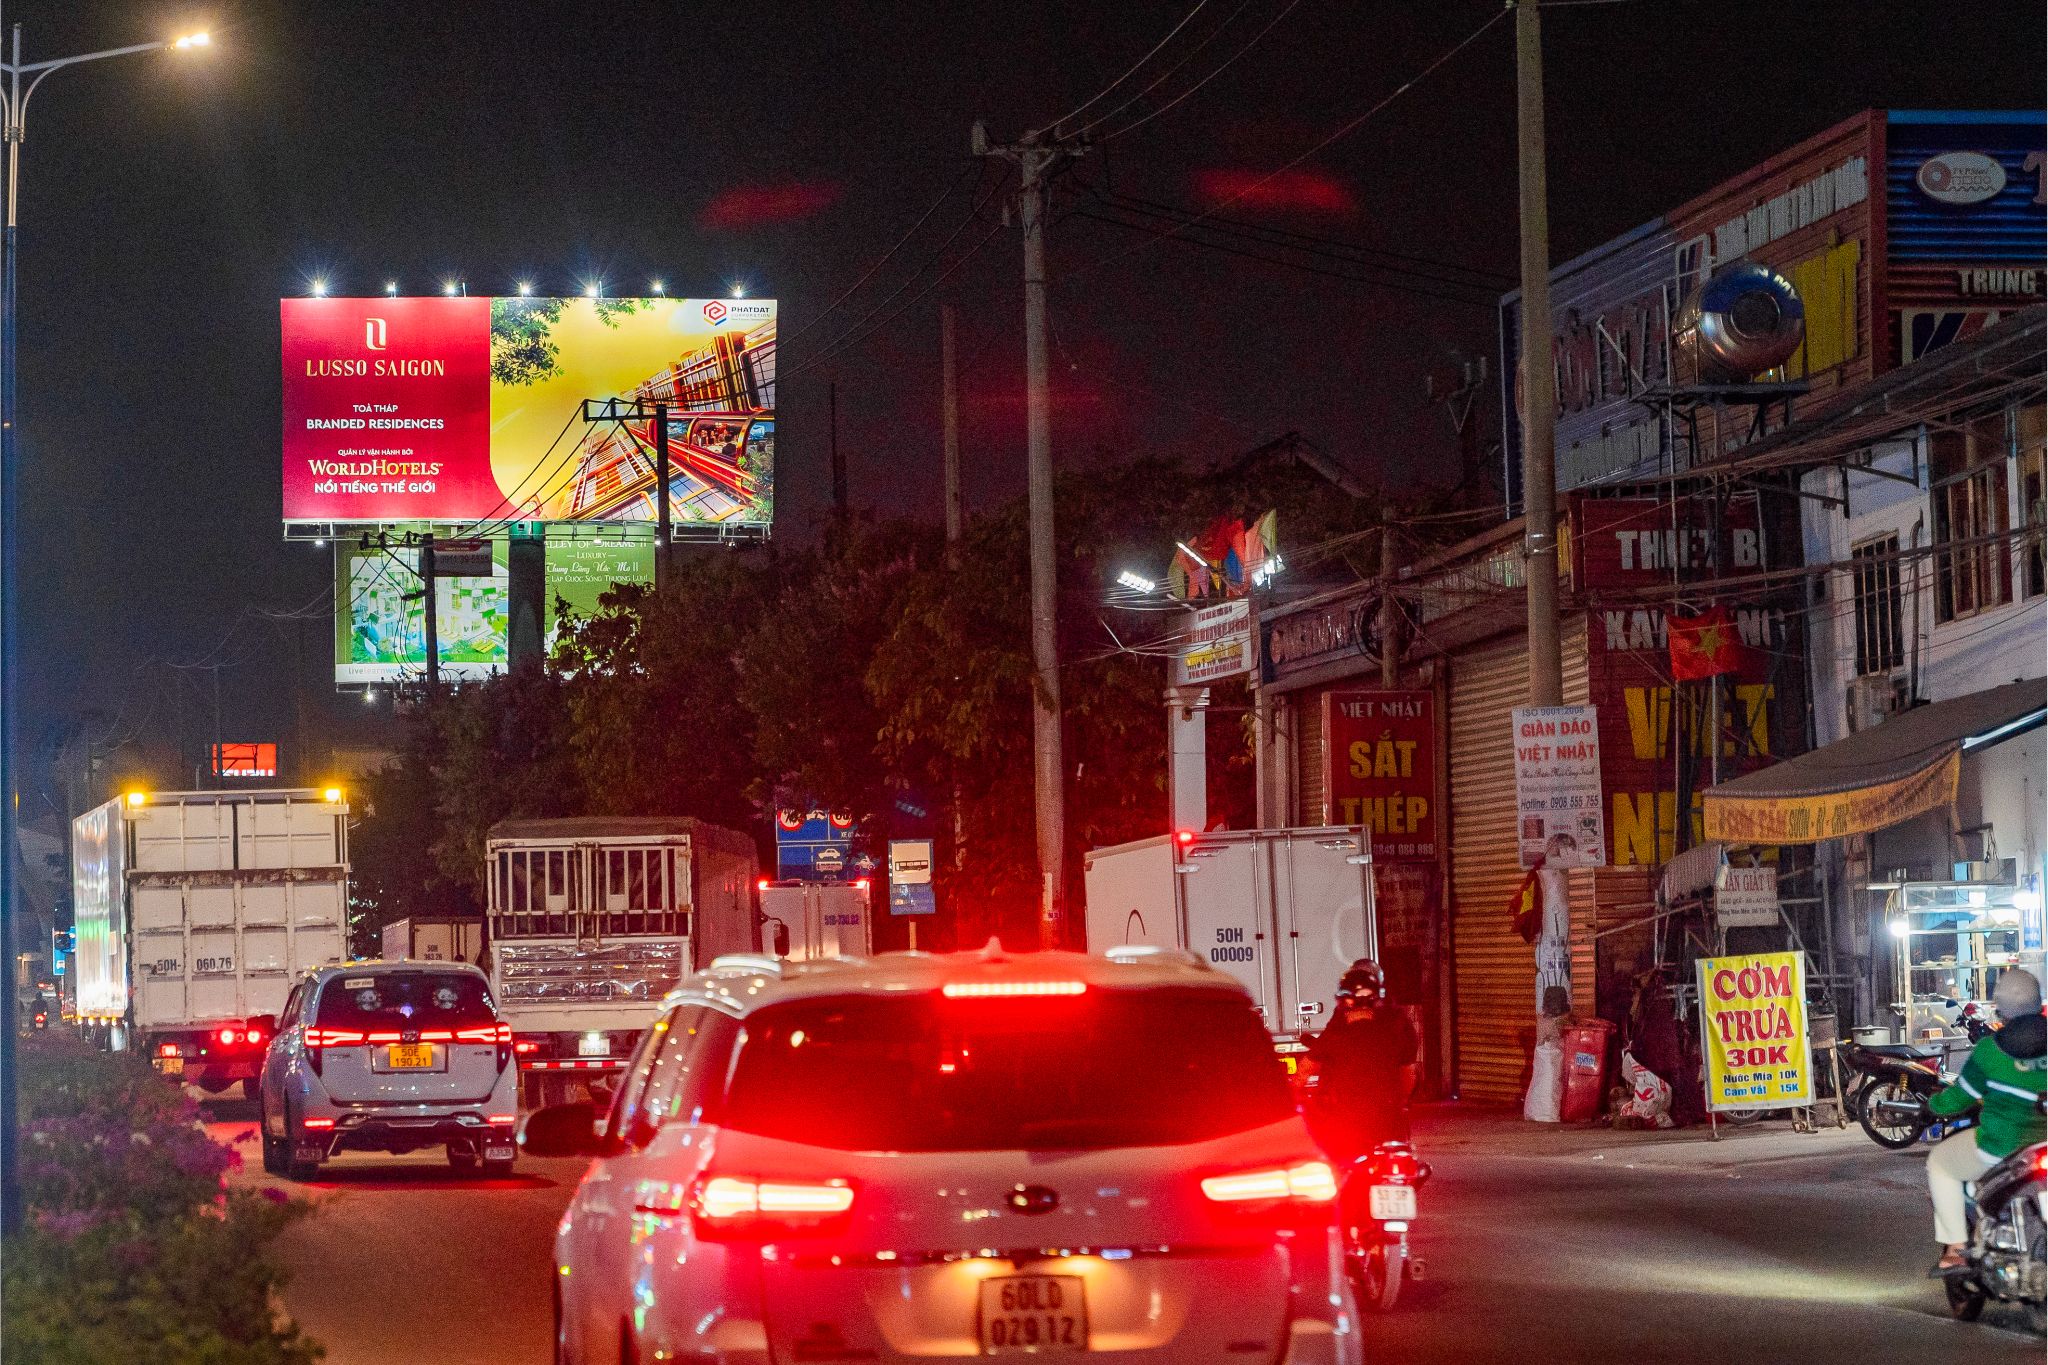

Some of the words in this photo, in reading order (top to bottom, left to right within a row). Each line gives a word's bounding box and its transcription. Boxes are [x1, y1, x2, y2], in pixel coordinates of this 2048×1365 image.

[1958, 269, 2037, 294] TRUNG
[306, 359, 367, 376] LUSSO
[374, 359, 445, 376] SAIGON
[353, 403, 372, 413] TOÀ
[374, 403, 399, 413] THÁP
[306, 419, 366, 429] BRANDED
[368, 419, 444, 429] RESIDENCES
[314, 479, 338, 493] NỔI
[340, 479, 378, 493] TIẾNG
[381, 479, 405, 493] THẾ
[408, 481, 436, 493] GIỚI
[576, 551, 607, 559] LUXURY
[1522, 708, 1539, 717] ISO
[1521, 719, 1556, 737] GIÀN
[1350, 729, 1417, 779] SẮT
[1518, 743, 1551, 763] VIỆT
[1556, 740, 1595, 761] NHẬT
[1550, 797, 1567, 808] 0908
[1586, 795, 1599, 807] 755
[1339, 791, 1428, 834] THÉP
[1216, 928, 1244, 943] 50H
[1210, 947, 1254, 962] 00009
[196, 957, 232, 971] 060.76
[1713, 961, 1793, 1001] CƠM
[1715, 1002, 1796, 1044] TRƯA
[401, 1048, 419, 1057] 50E
[1726, 1045, 1790, 1069] 30K
[395, 1057, 427, 1067] 190.21
[1723, 1072, 1750, 1084] Nước
[1752, 1071, 1773, 1082] Mía
[1779, 1070, 1798, 1080] 10K
[1724, 1088, 1748, 1098] Cam
[1780, 1083, 1799, 1093] 15K
